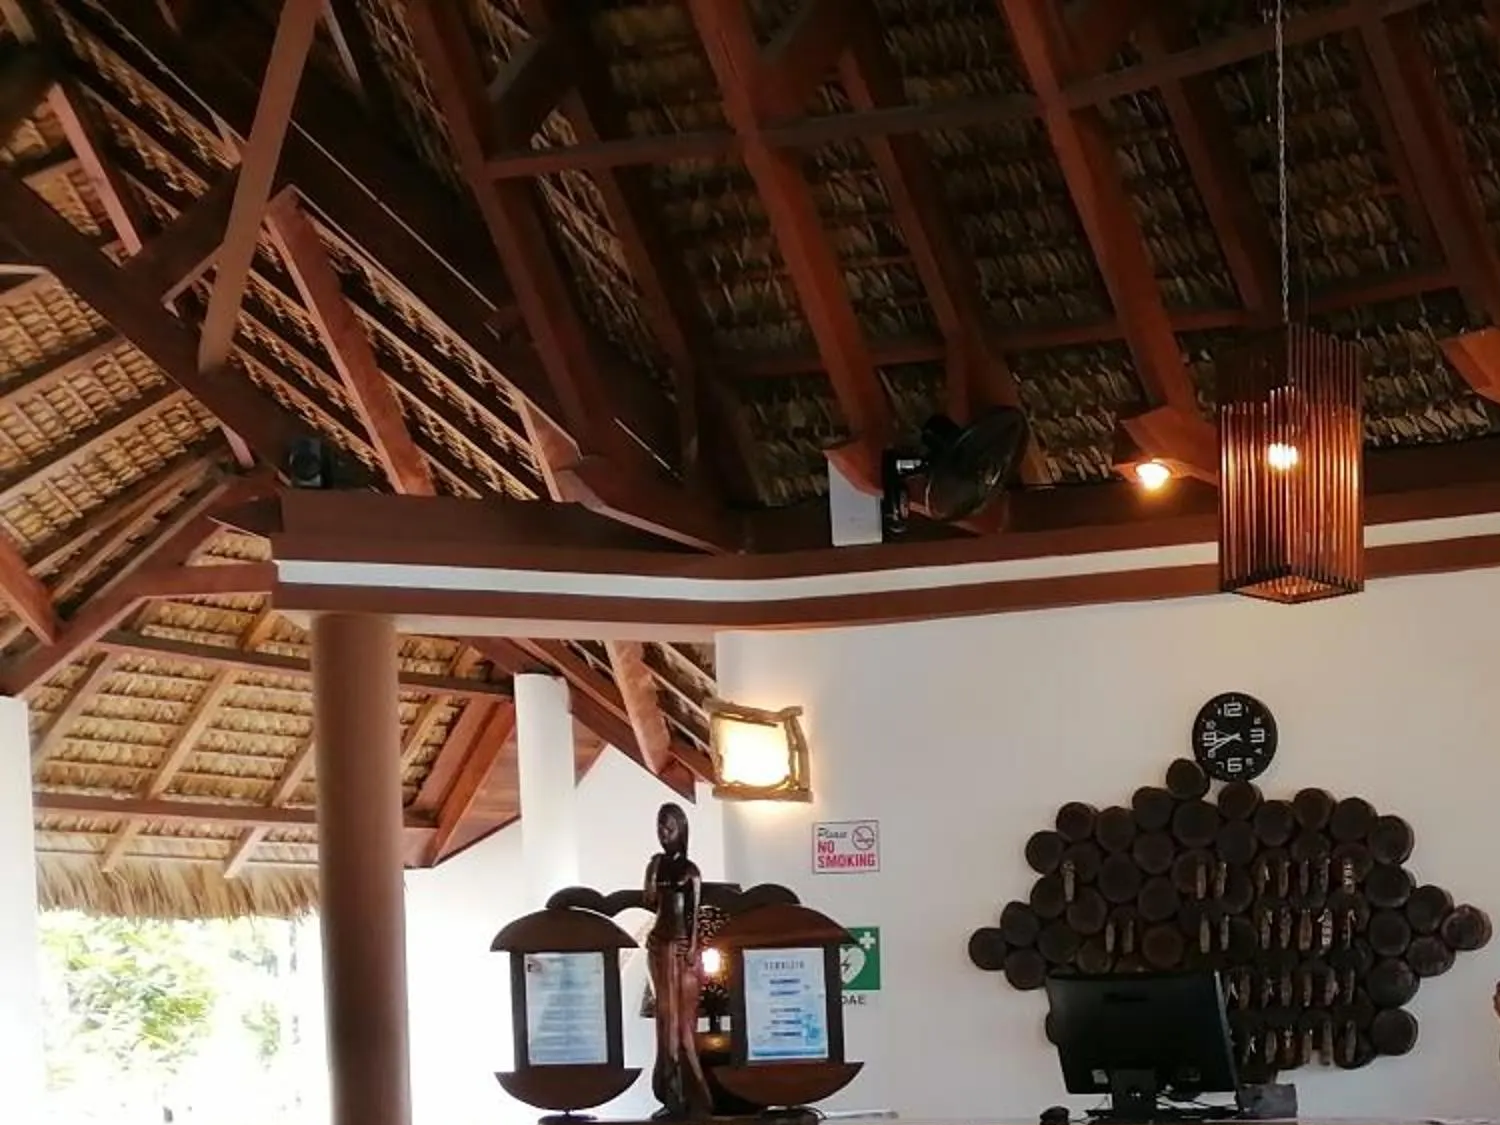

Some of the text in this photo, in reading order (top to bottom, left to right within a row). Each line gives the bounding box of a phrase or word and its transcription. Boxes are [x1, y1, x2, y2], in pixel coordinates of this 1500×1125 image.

[1224, 702, 1242, 717] 12
[1250, 728, 1265, 743] 3
[1227, 757, 1242, 773] 6
[817, 840, 835, 853] NO
[817, 853, 876, 868] SMOKING
